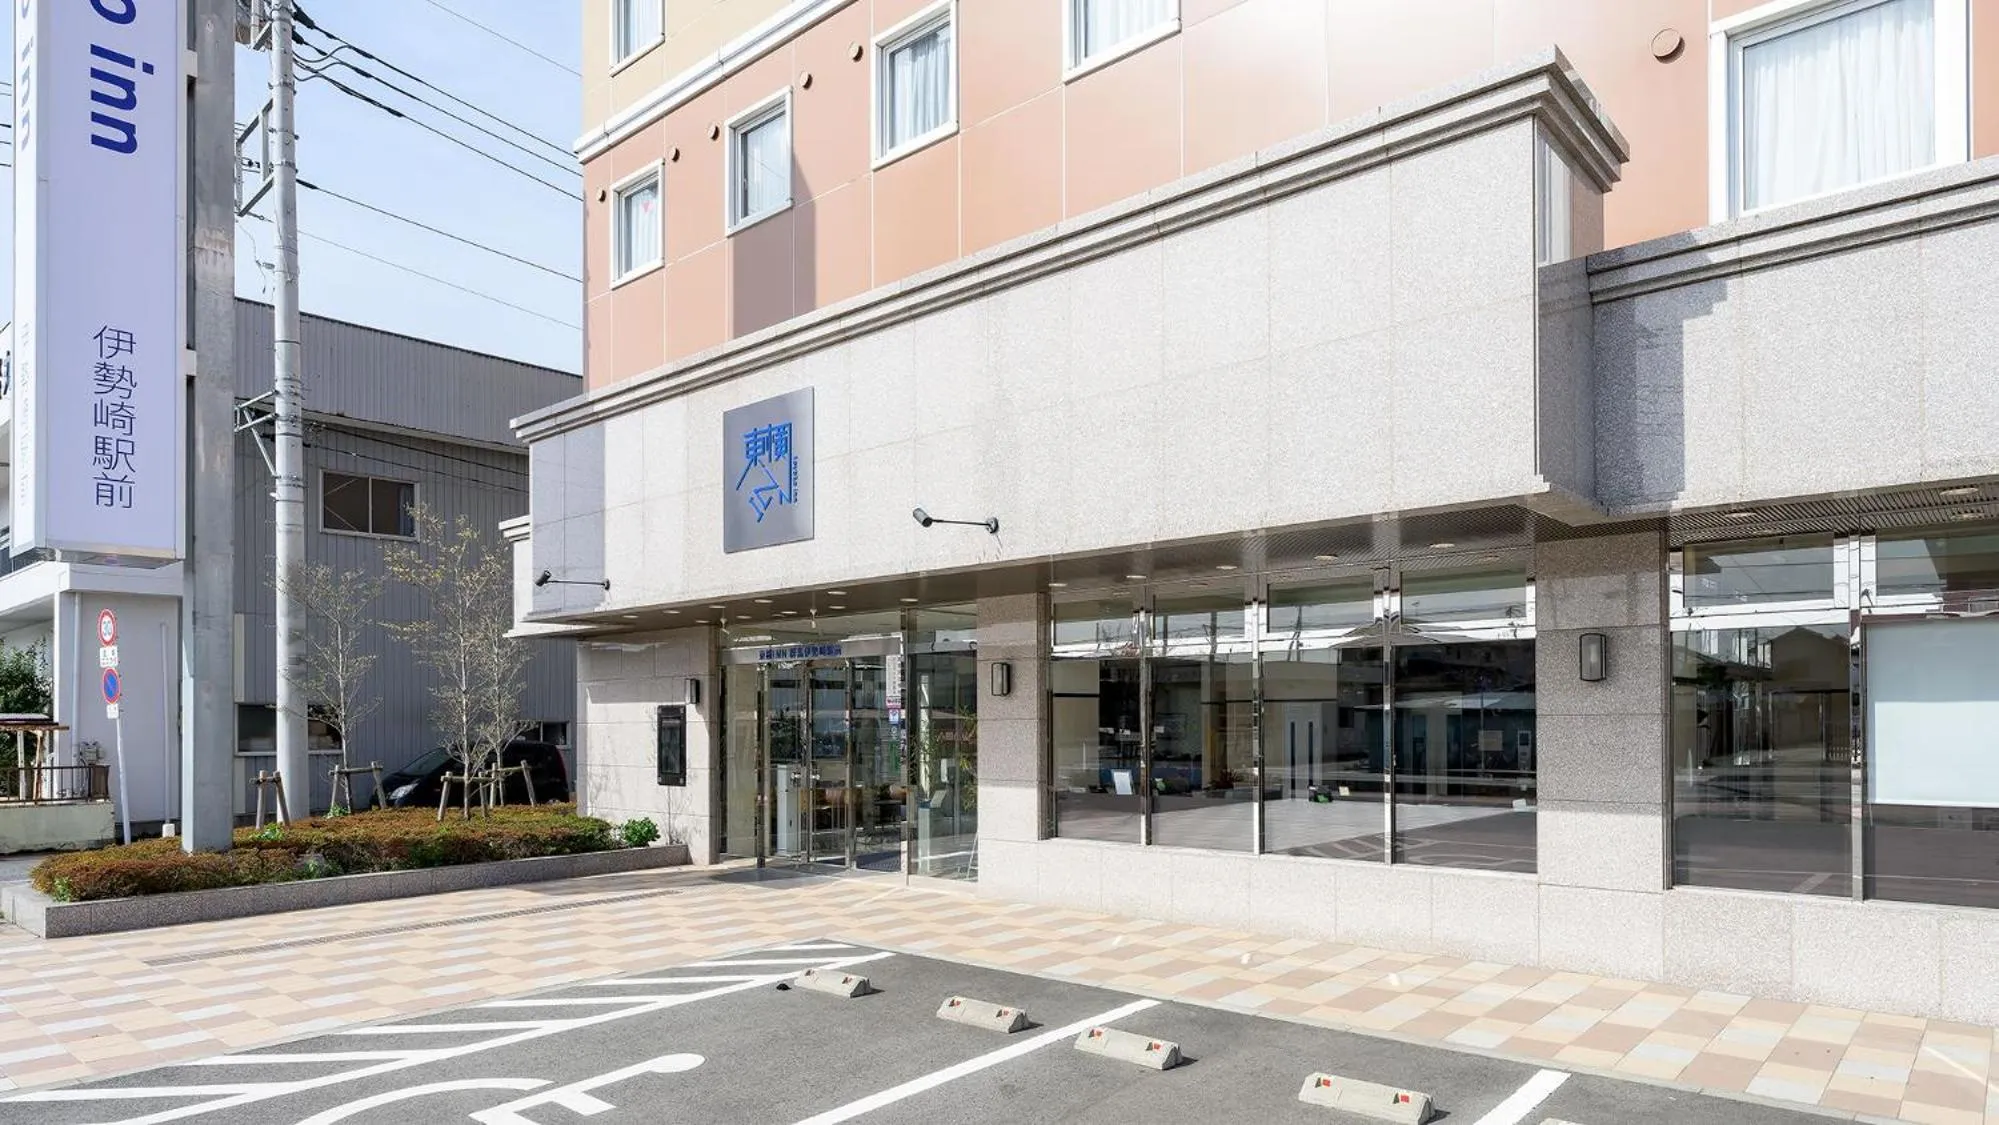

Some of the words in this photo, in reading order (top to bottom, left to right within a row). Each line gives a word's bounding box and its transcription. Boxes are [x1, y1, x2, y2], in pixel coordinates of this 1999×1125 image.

[90, 43, 154, 154] inn
[93, 324, 137, 509] 伊勢崎駅前
